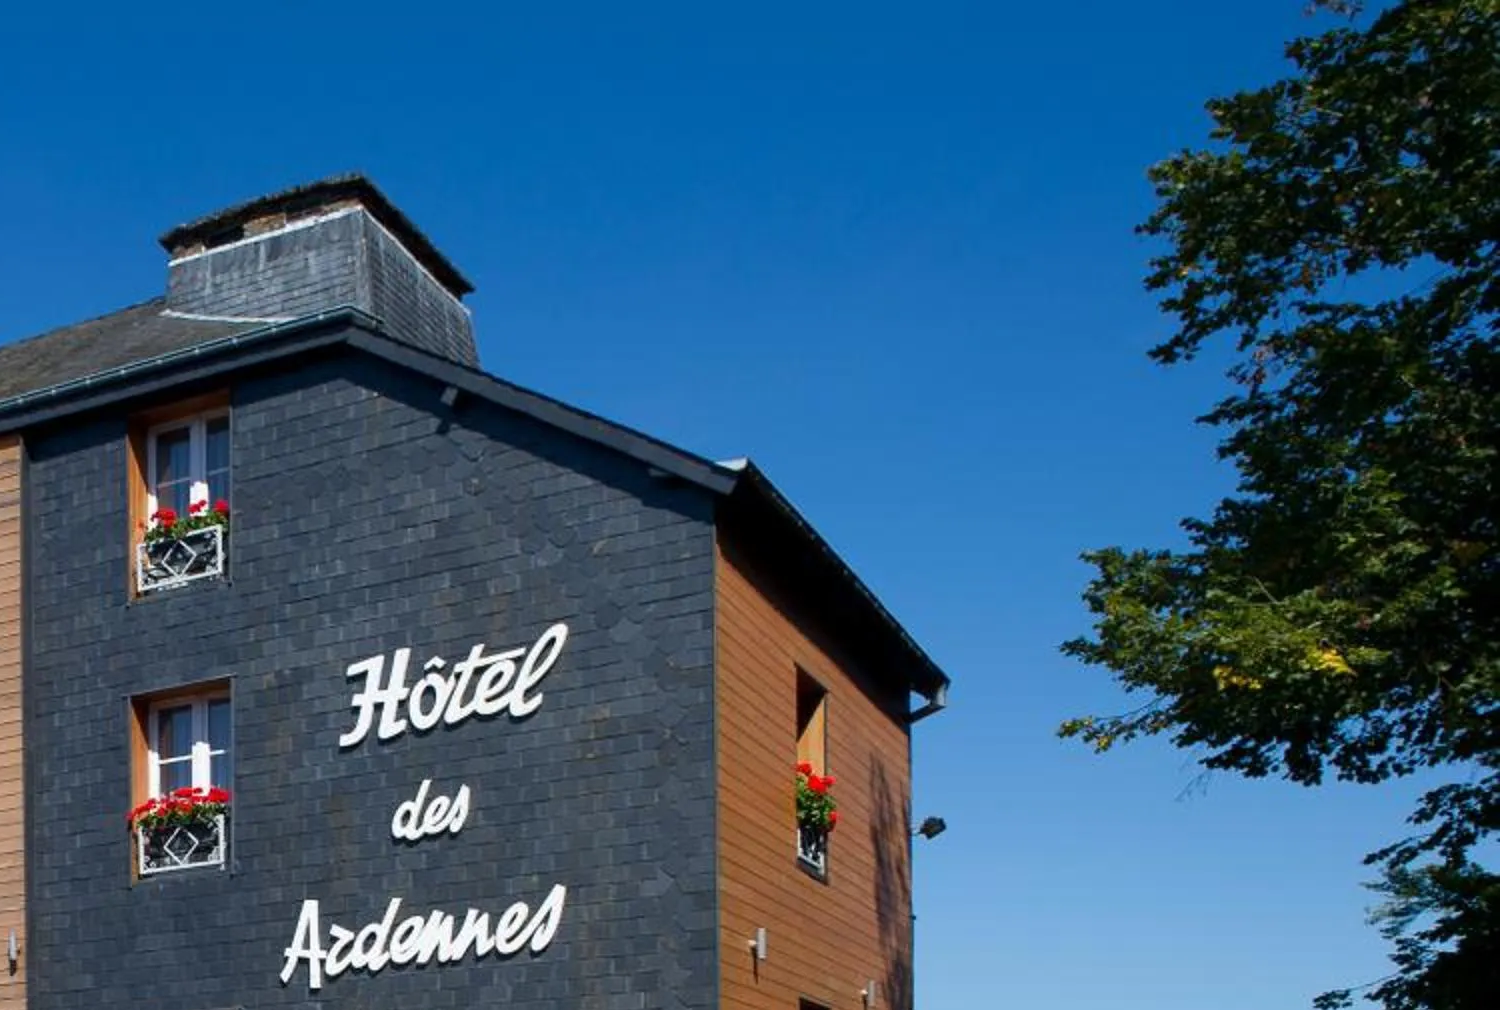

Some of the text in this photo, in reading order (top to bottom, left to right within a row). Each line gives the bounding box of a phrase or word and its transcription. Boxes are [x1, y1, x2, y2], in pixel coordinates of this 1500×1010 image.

[338, 622, 569, 748] Hôtel
[391, 779, 471, 841] des
[279, 883, 568, 990] Ardennes
